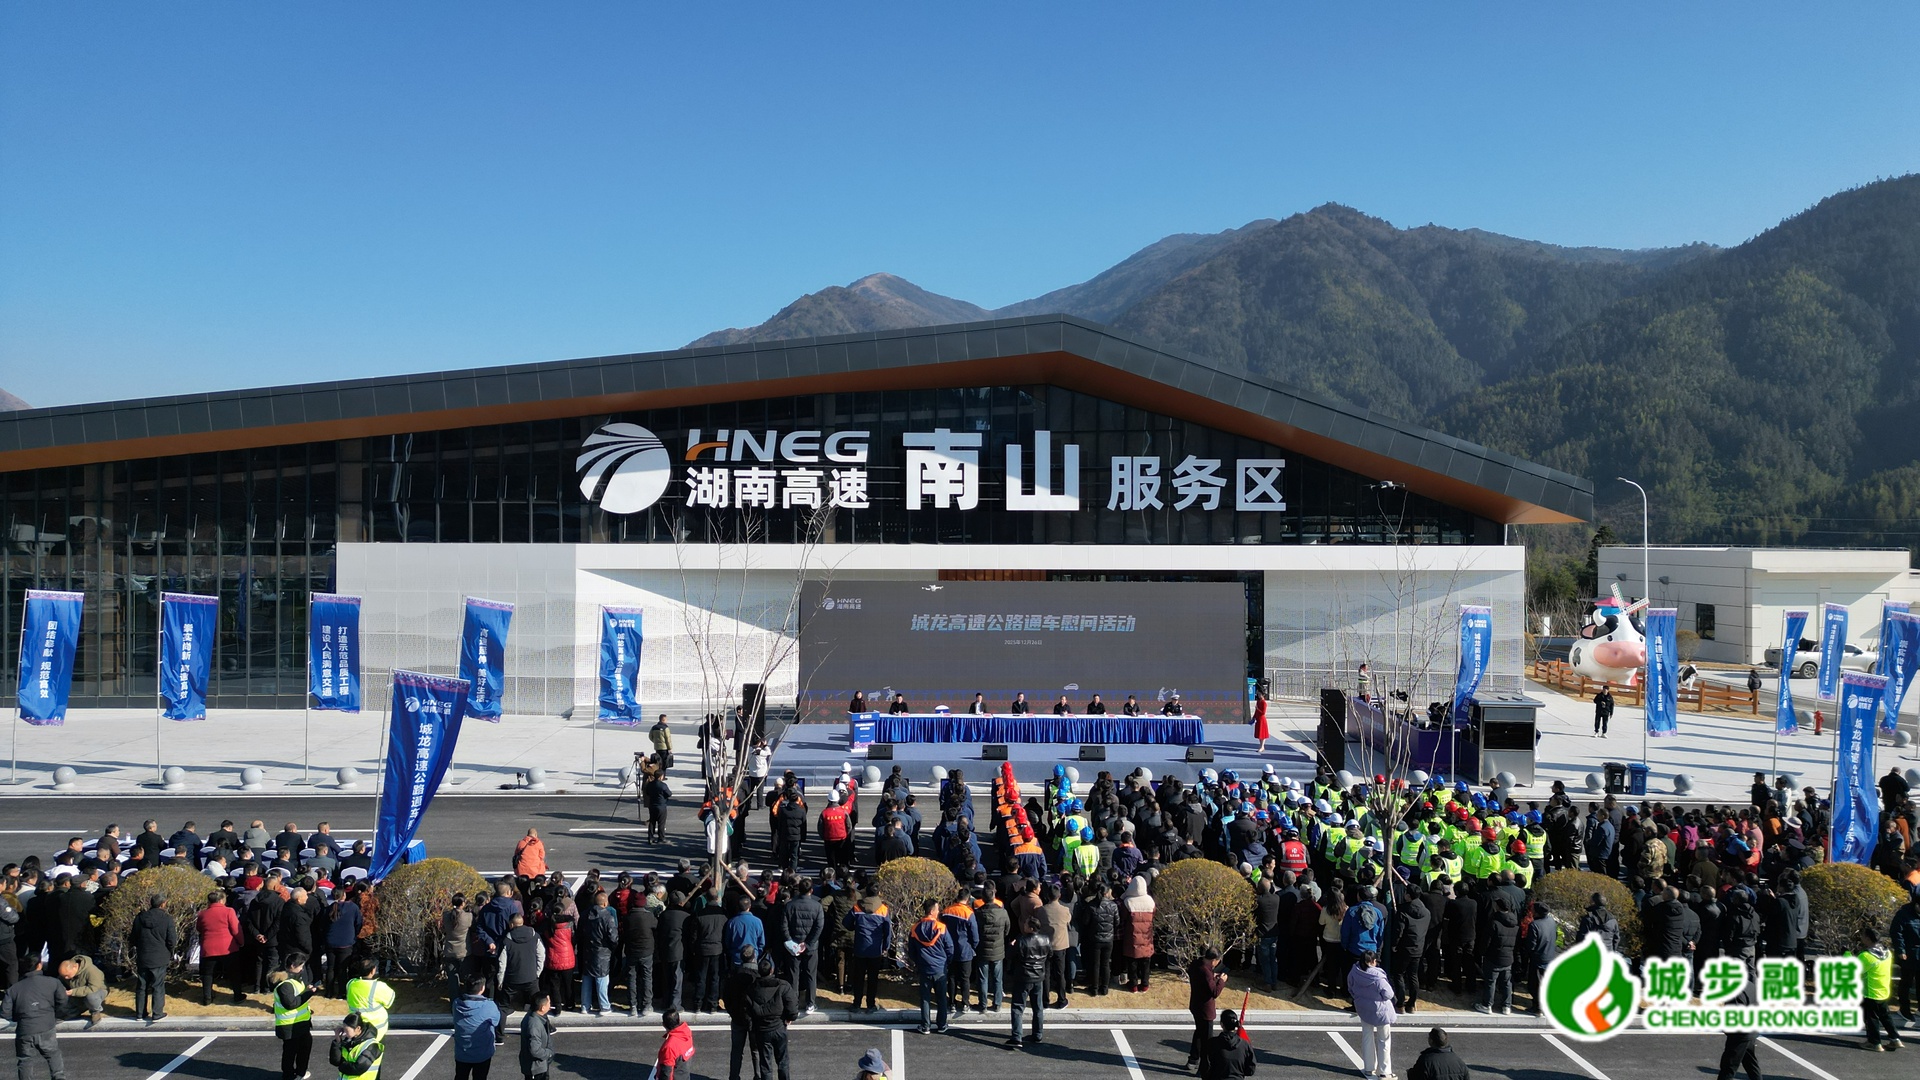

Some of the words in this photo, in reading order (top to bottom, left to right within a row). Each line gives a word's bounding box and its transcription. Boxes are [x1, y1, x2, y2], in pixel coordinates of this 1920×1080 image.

[685, 429, 870, 463] HNEG
[685, 467, 870, 510] 湖南高速
[42, 620, 58, 658] 团结奉献
[910, 614, 1136, 632] 城龙高速公路通车慰问活动
[39, 661, 52, 699] 规范高效
[321, 625, 333, 697] 建设人民满意交通
[338, 626, 350, 696] 打造示范品质工程
